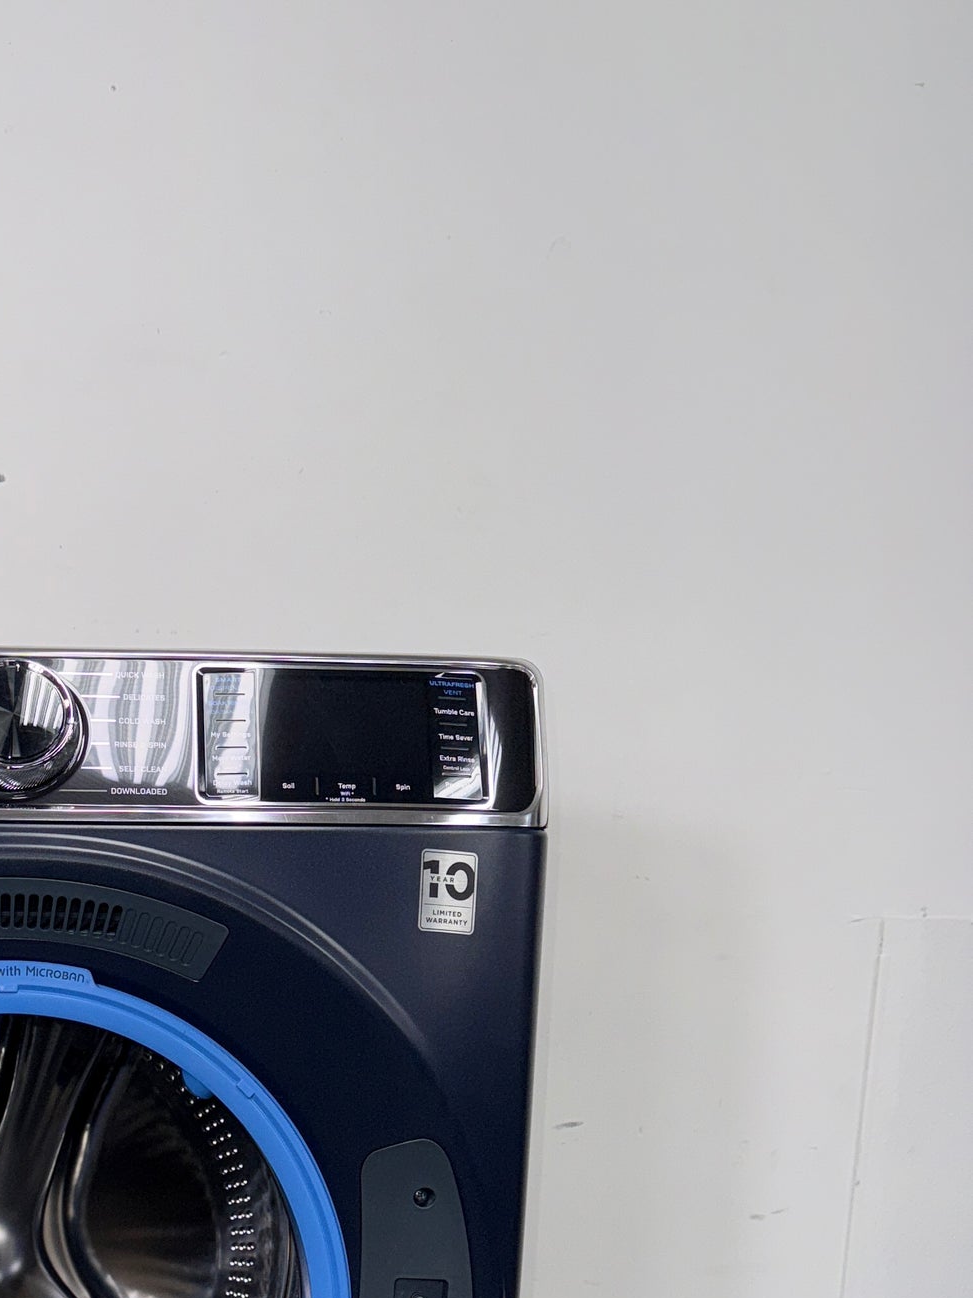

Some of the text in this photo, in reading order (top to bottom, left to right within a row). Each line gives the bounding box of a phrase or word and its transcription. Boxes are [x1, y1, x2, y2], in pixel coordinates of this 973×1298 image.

[429, 680, 475, 689] ULTRAFRESH
[433, 707, 458, 715] Tumble
[118, 717, 140, 725] COLD
[455, 734, 473, 742] Saver
[337, 783, 357, 791] Temp
[395, 784, 411, 792] Spin
[111, 788, 168, 796] DOWNLOADED
[423, 860, 475, 901] 10
[432, 909, 462, 918] LIMITED
[426, 917, 468, 926] WARRANTY
